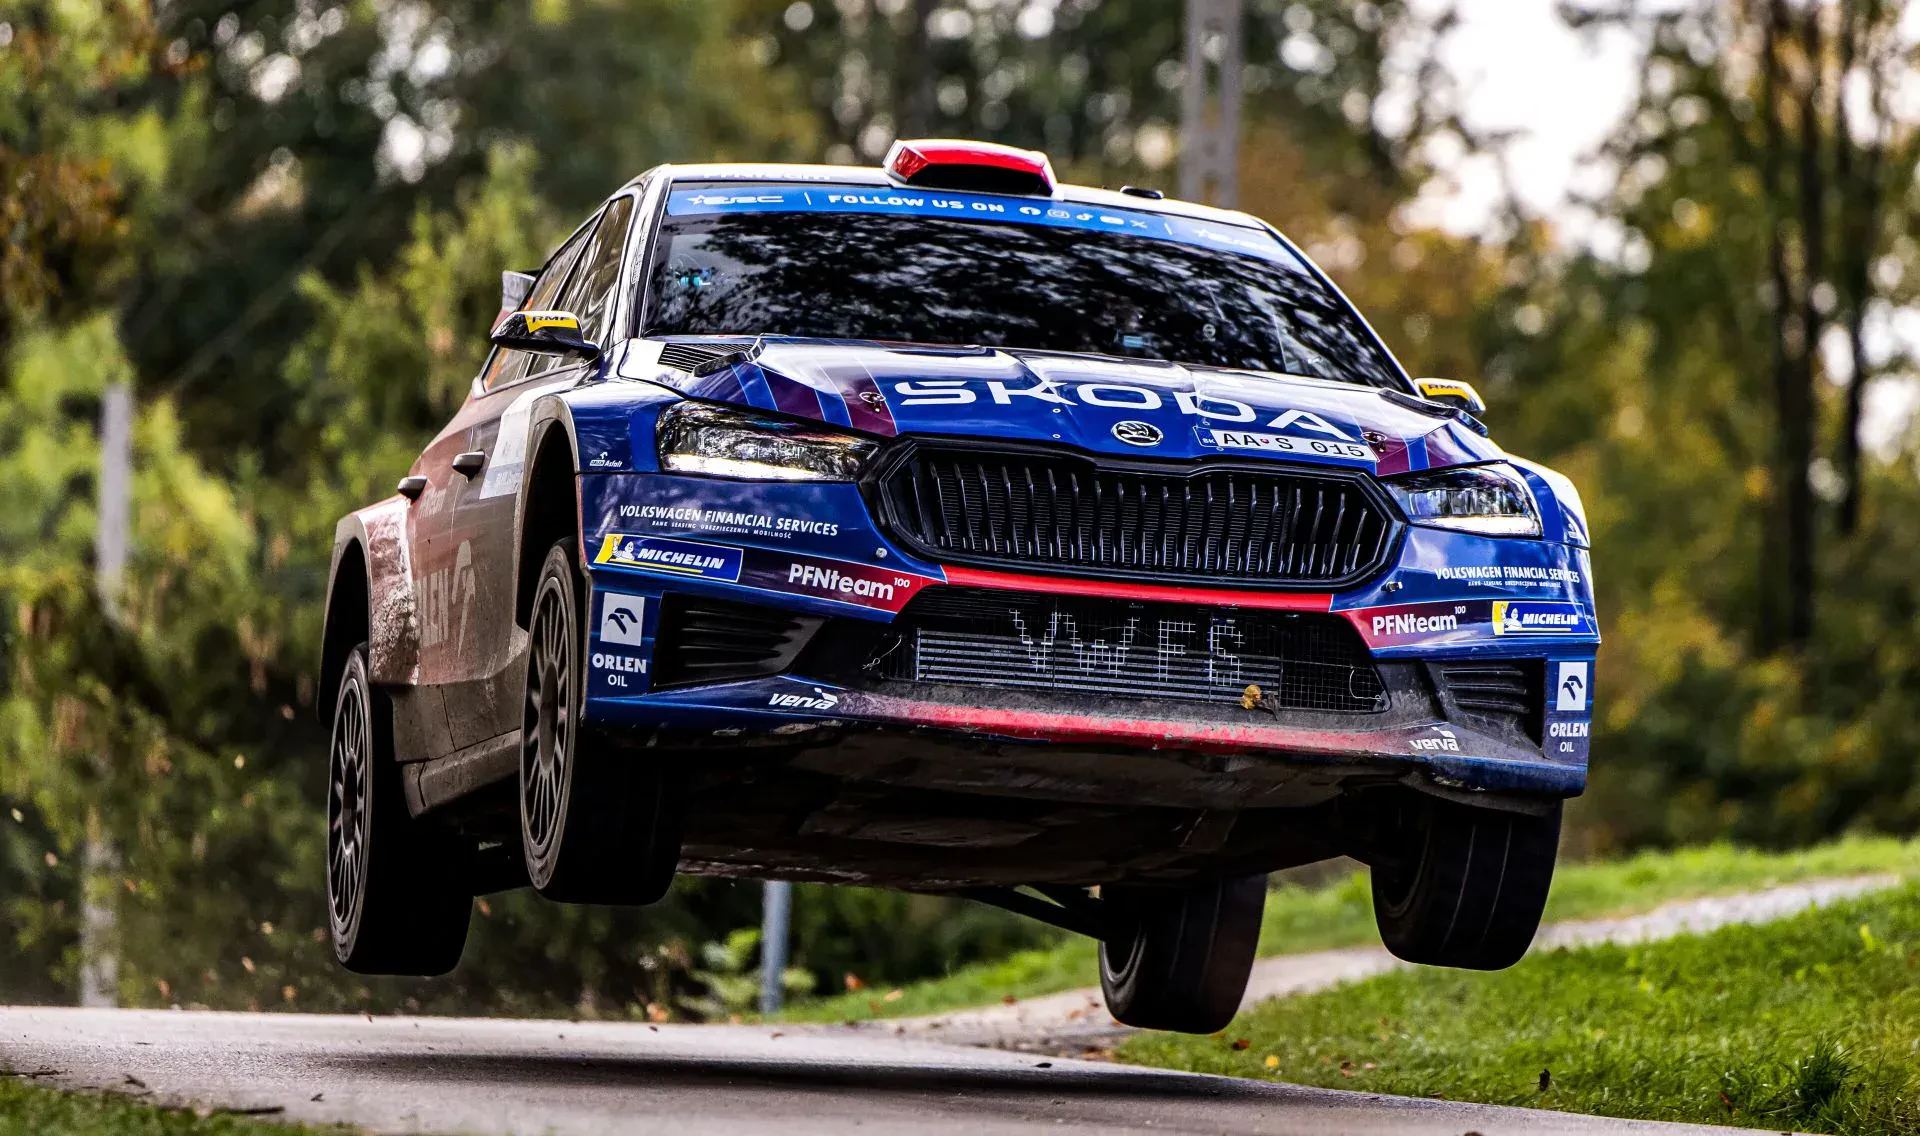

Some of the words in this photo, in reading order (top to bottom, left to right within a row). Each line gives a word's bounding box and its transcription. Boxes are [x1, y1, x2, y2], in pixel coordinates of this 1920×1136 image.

[828, 194, 924, 207] FOLLOW
[932, 199, 965, 210] US
[971, 201, 1005, 213] ON
[532, 315, 570, 324] RMF
[1202, 437, 1216, 445] SK
[1223, 432, 1262, 447] AA
[1275, 437, 1294, 450] S
[1310, 441, 1366, 457] 015
[619, 504, 702, 521] VOLKSWAGEN
[704, 510, 773, 529] FINANCIAL
[775, 517, 838, 537] SERVICES
[637, 547, 725, 570] MICHELIN
[788, 563, 894, 600] PFNteam
[893, 576, 910, 589] 100
[1434, 566, 1501, 580] VOLKSWAGEN
[1503, 567, 1548, 580] FINANCIAL
[1548, 568, 1580, 583] SERVICES
[1372, 612, 1457, 636] PFNteam
[1454, 605, 1466, 615] 100
[1522, 613, 1579, 626] MICHELIN
[592, 653, 647, 675] ORLEN
[607, 674, 628, 688] OIL
[768, 691, 838, 711] verva
[1549, 722, 1588, 738] ORLEN
[1408, 736, 1460, 752] verva
[1559, 741, 1575, 753] OIL
